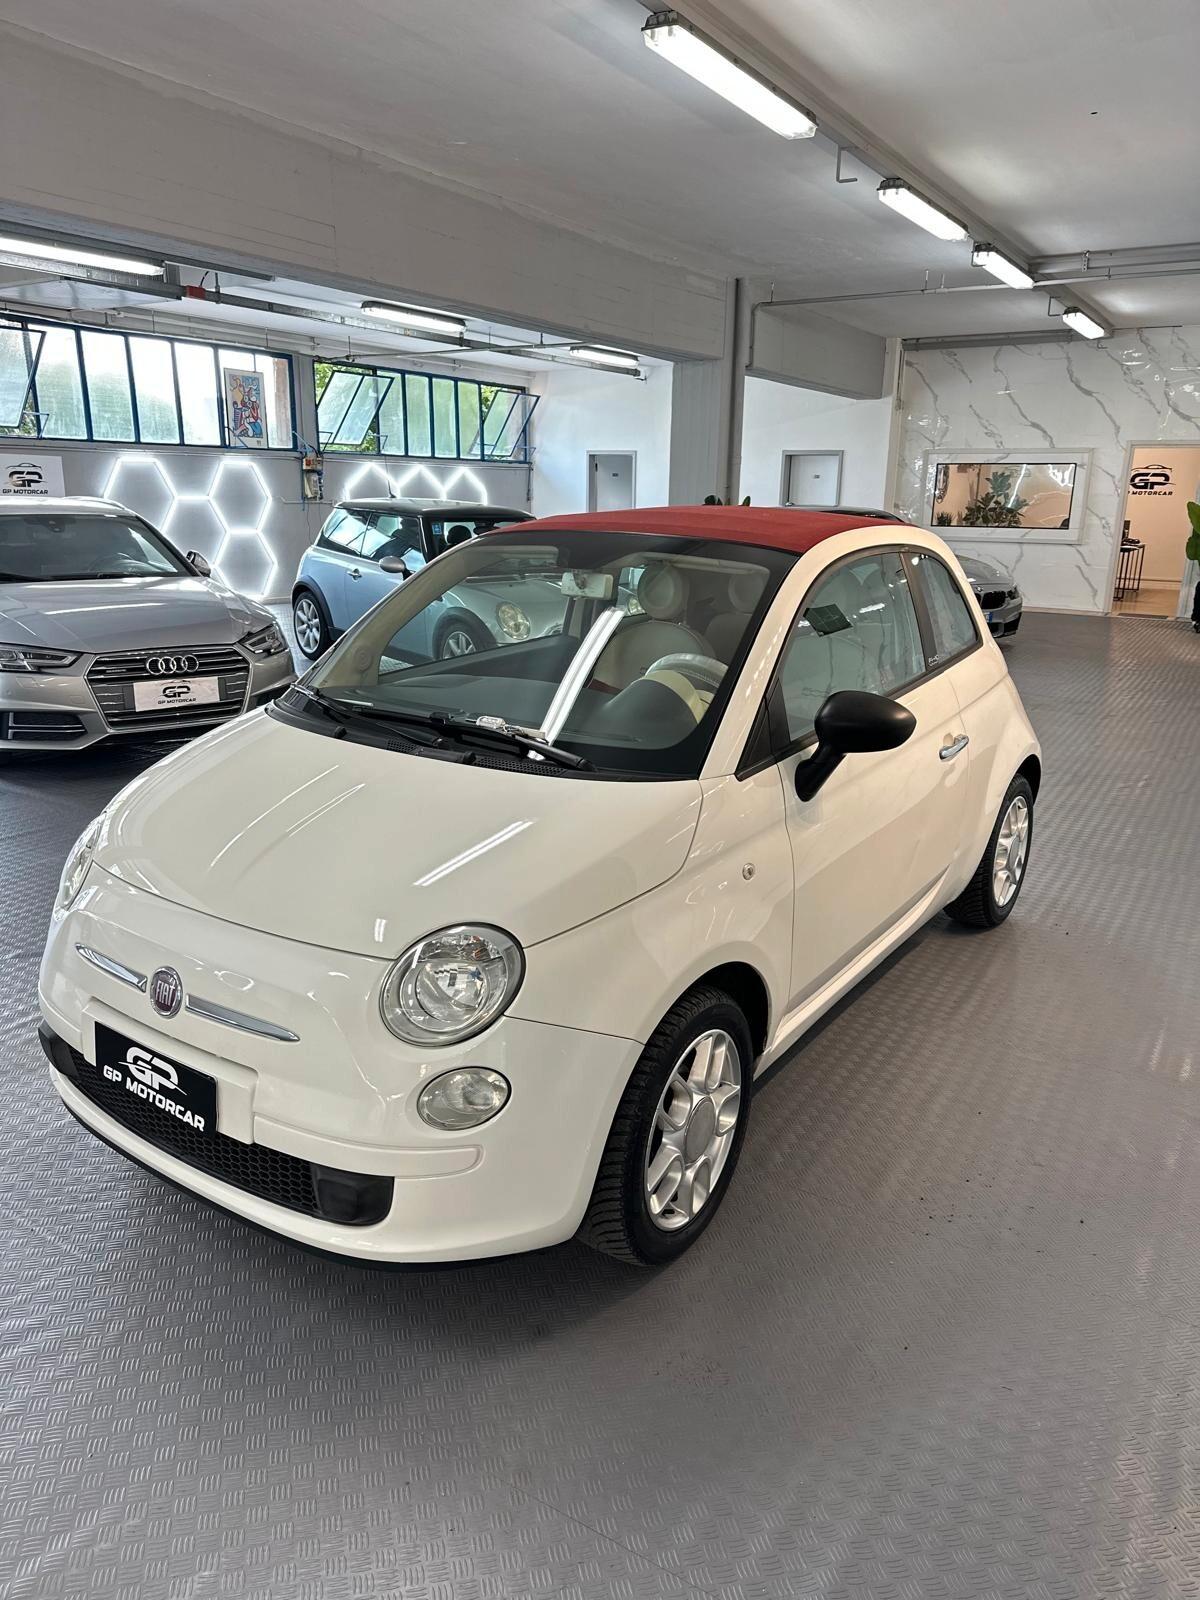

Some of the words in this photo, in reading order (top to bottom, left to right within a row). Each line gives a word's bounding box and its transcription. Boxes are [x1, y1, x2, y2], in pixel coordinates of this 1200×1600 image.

[155, 979, 176, 1007] FIAT
[103, 1064, 123, 1083] GP
[125, 1077, 206, 1133] MOTORCAR
